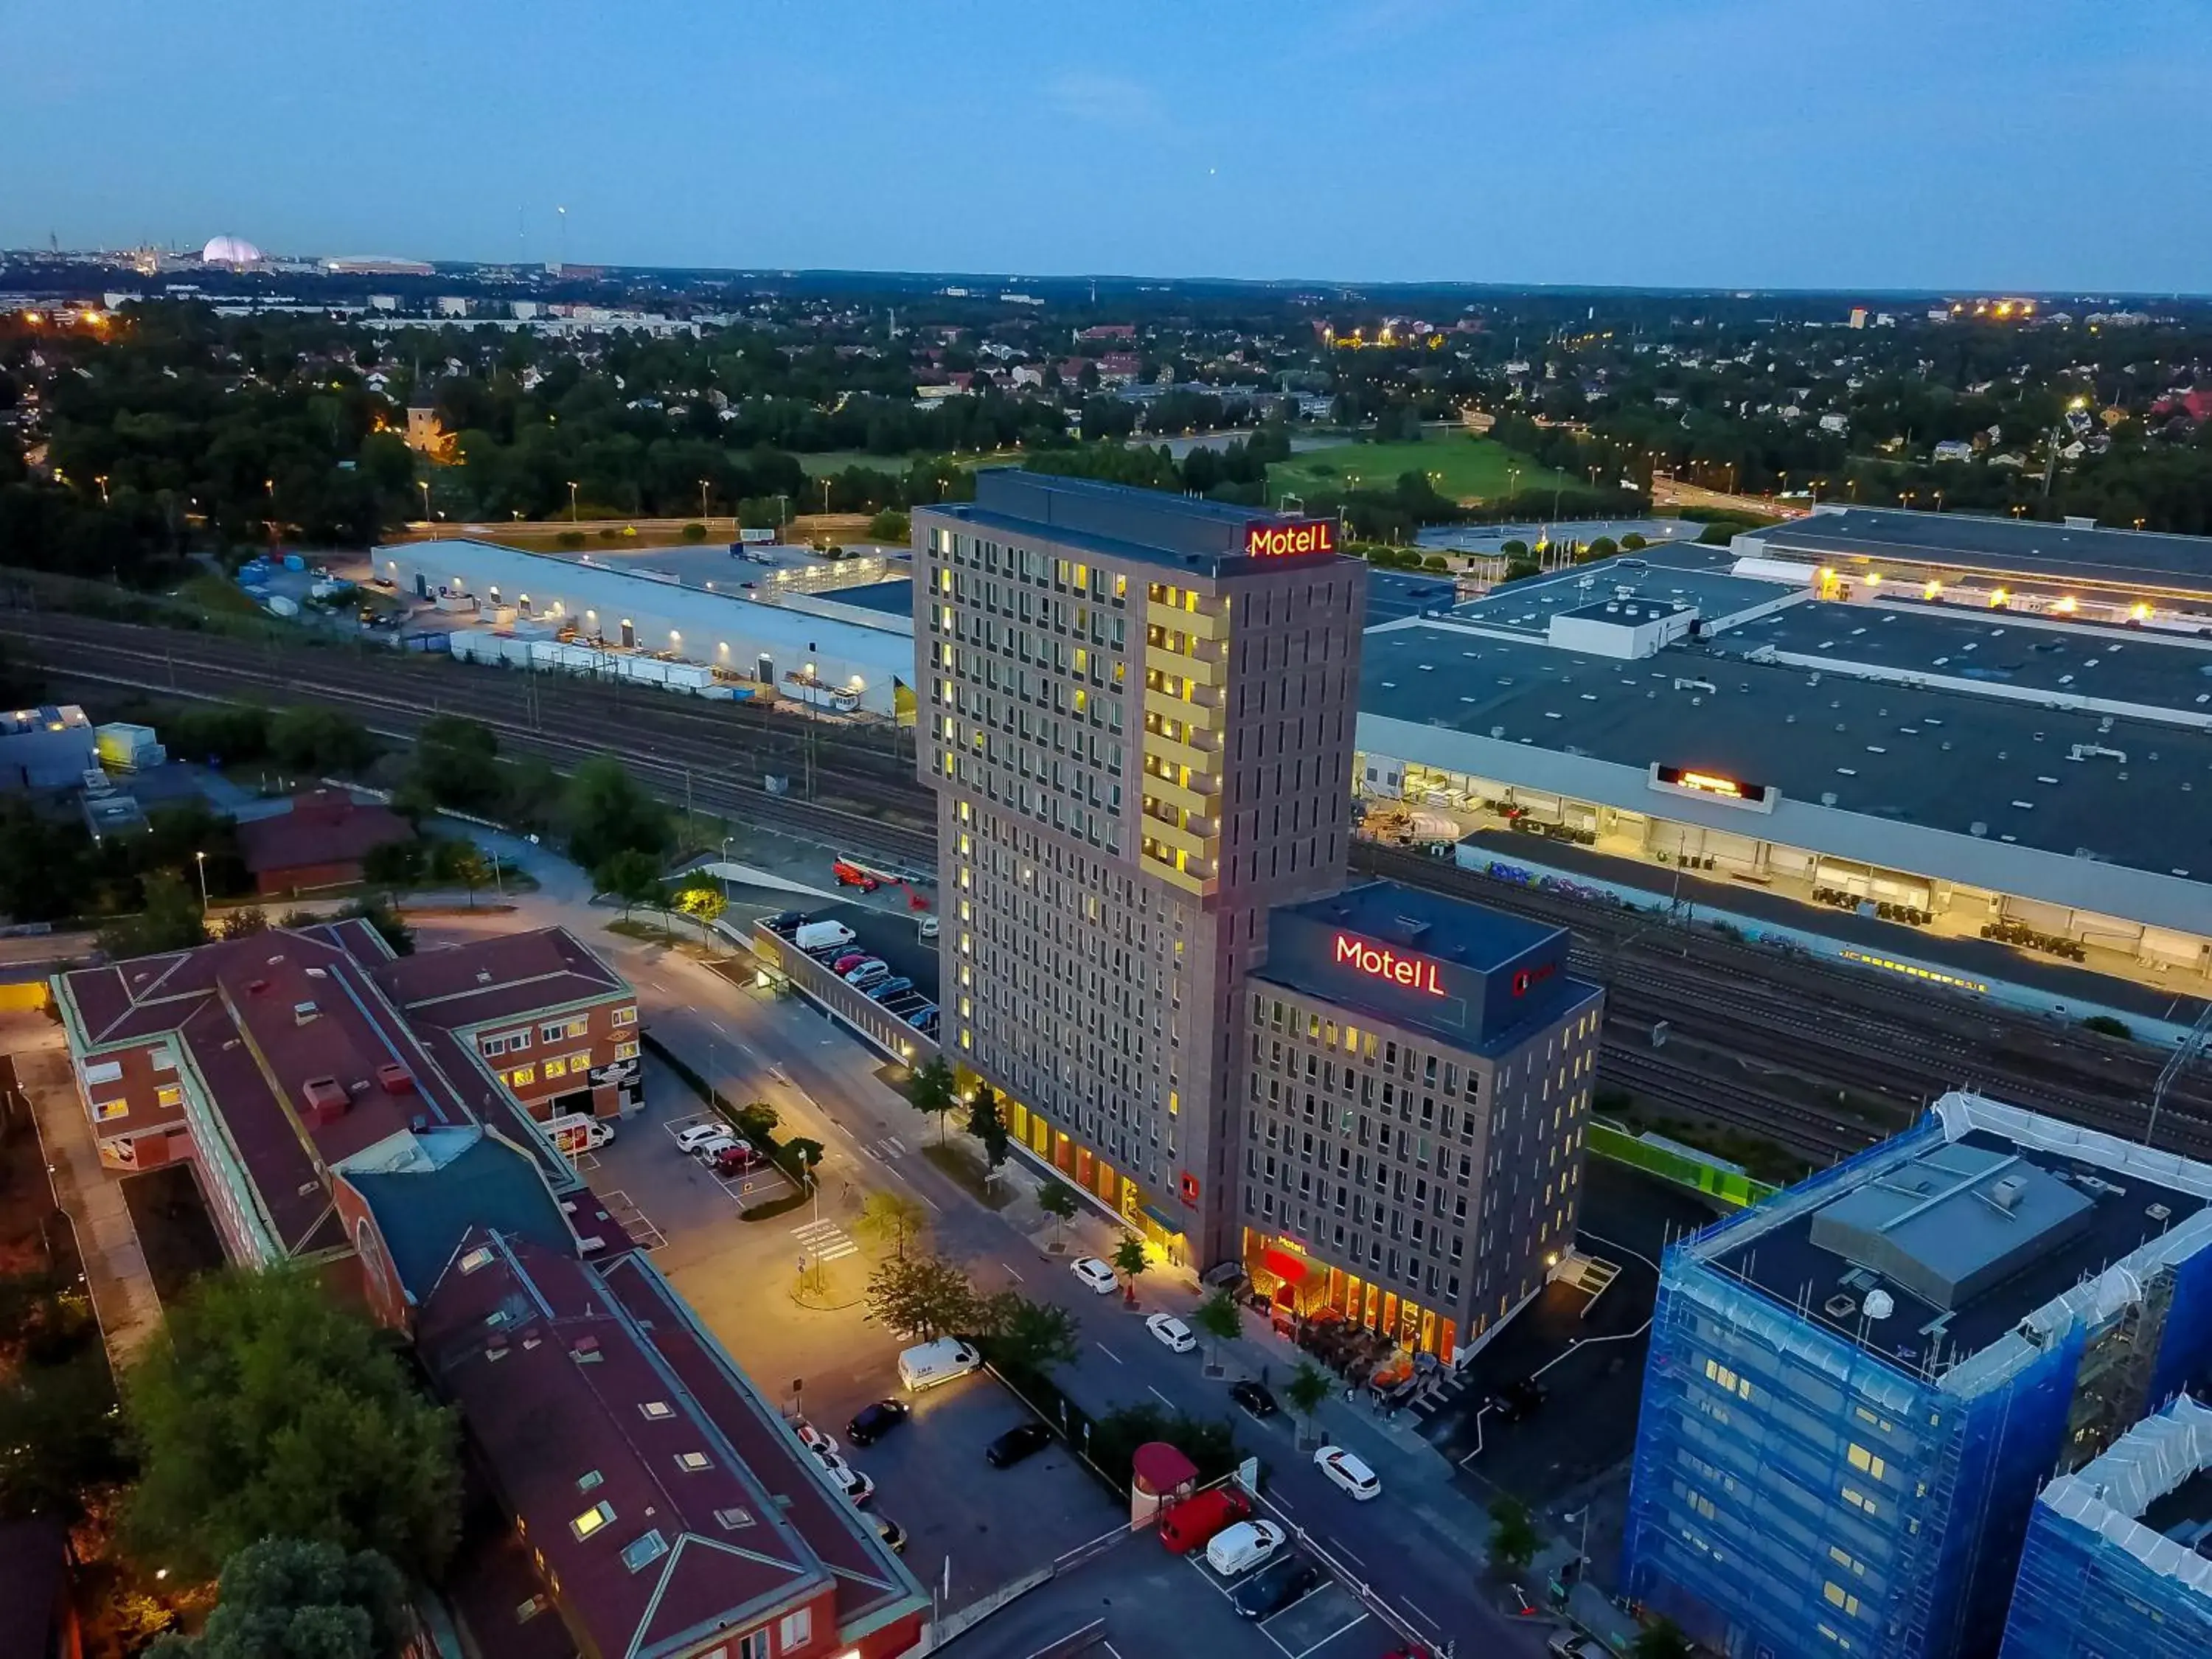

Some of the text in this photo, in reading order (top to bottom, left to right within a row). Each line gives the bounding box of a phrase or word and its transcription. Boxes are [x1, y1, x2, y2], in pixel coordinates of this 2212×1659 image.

[1251, 524, 1332, 557] Motel L
[1336, 935, 1444, 995] Motel L
